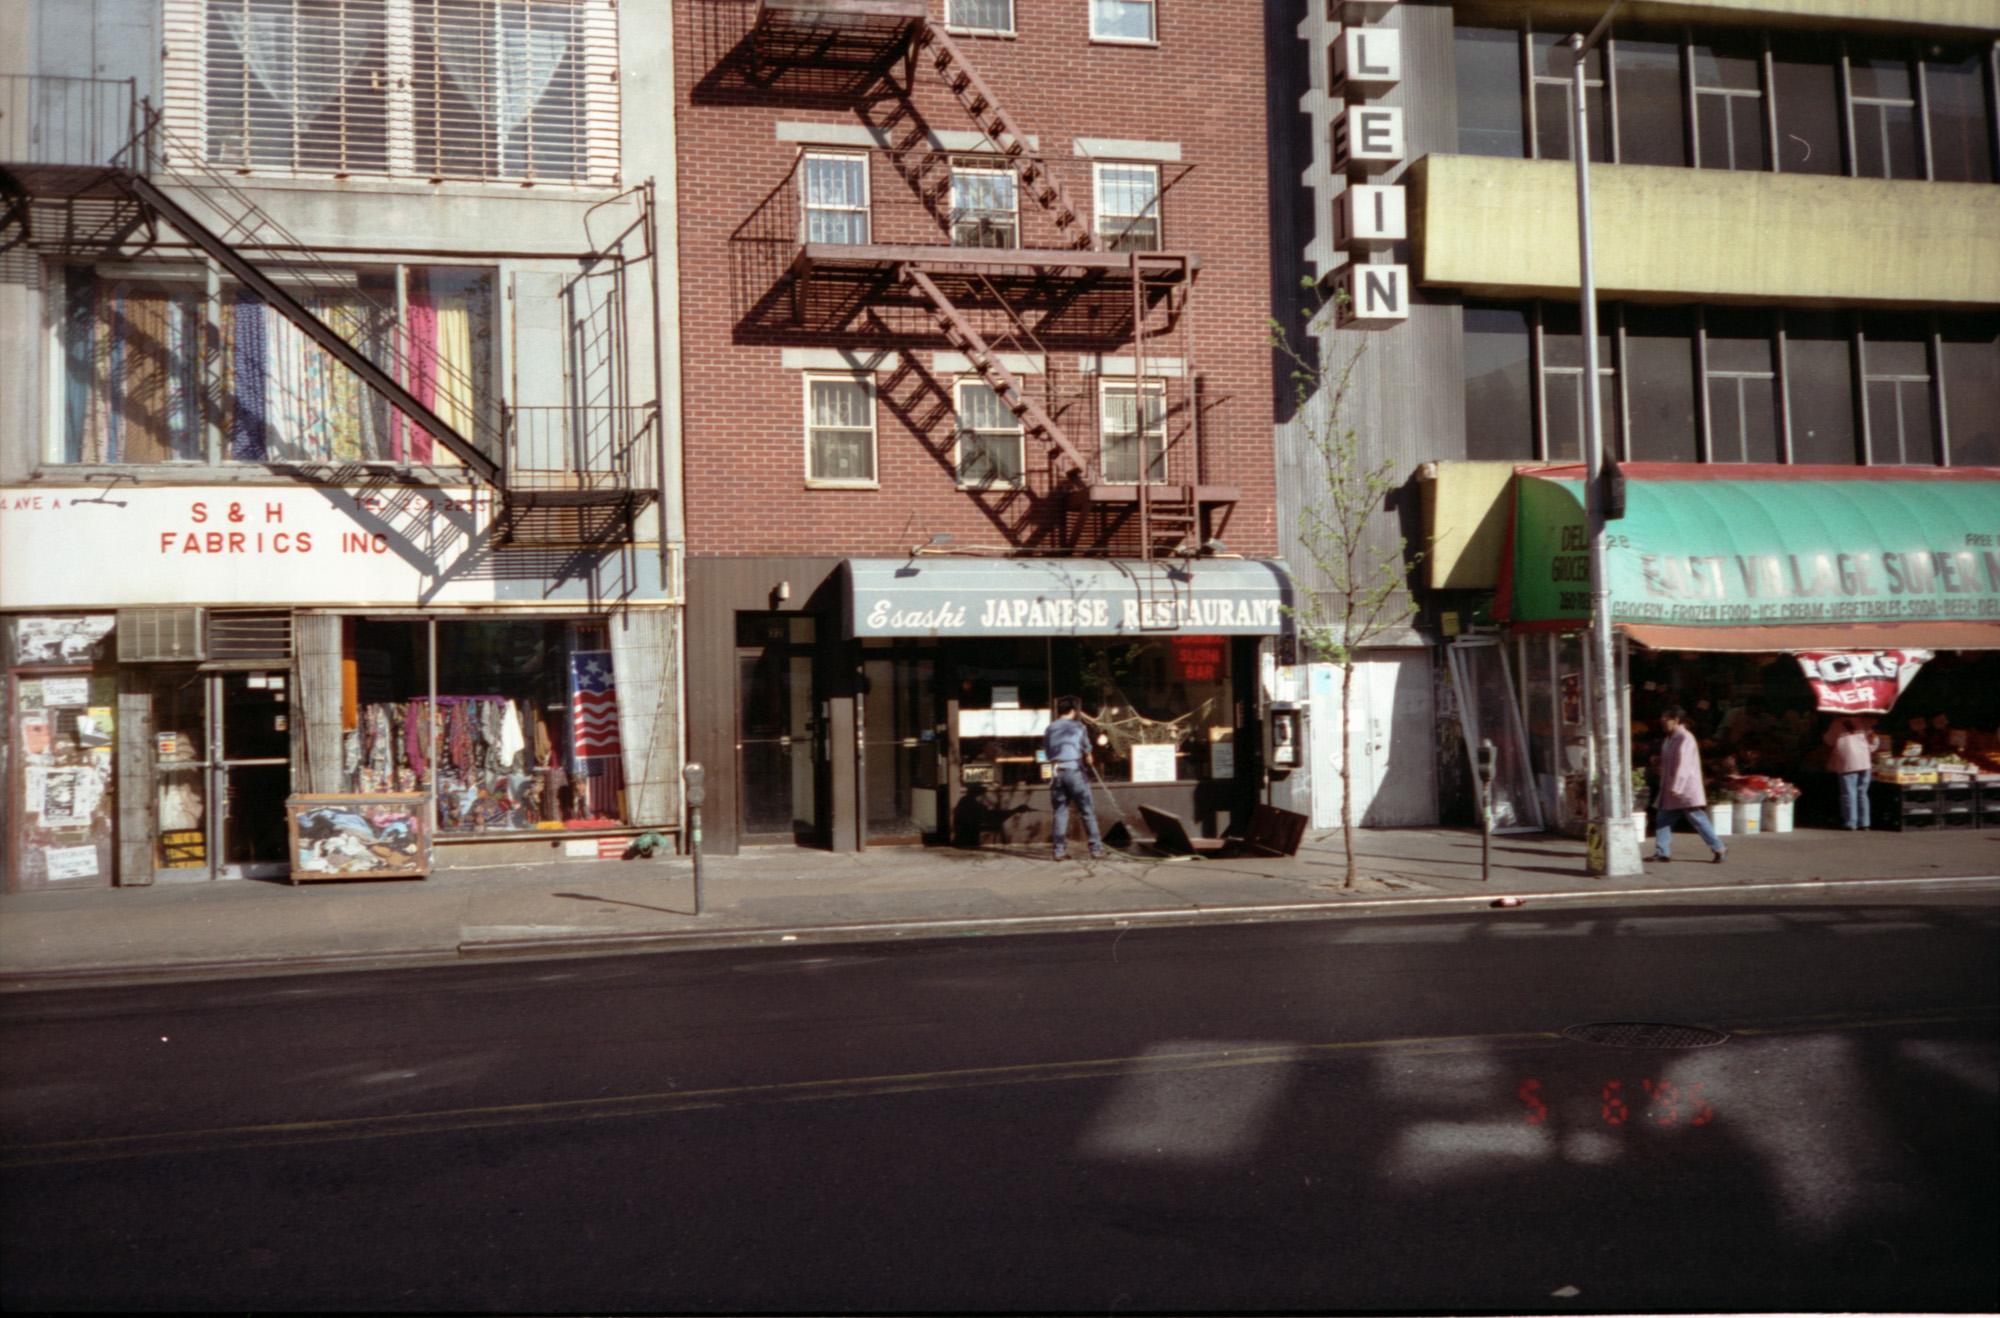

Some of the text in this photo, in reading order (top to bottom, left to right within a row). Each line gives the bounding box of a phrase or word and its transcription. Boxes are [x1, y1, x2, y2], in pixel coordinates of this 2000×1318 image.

[14, 496, 43, 510] AVE
[52, 498, 62, 510] A
[191, 501, 283, 524] S & H
[160, 532, 388, 555] FABRICS INC
[1641, 555, 1727, 599] EAST
[1735, 554, 1878, 598] VILLAGE
[1882, 551, 1984, 594] SUPER
[866, 598, 1281, 629] Esashi JAPANESE RESTAURANT
[1612, 601, 1664, 617] GROCERY
[1672, 603, 1717, 619] FROZEN
[1720, 604, 1750, 619] FOOD
[1759, 603, 1777, 618] ICE
[1781, 602, 1824, 618] CREAM
